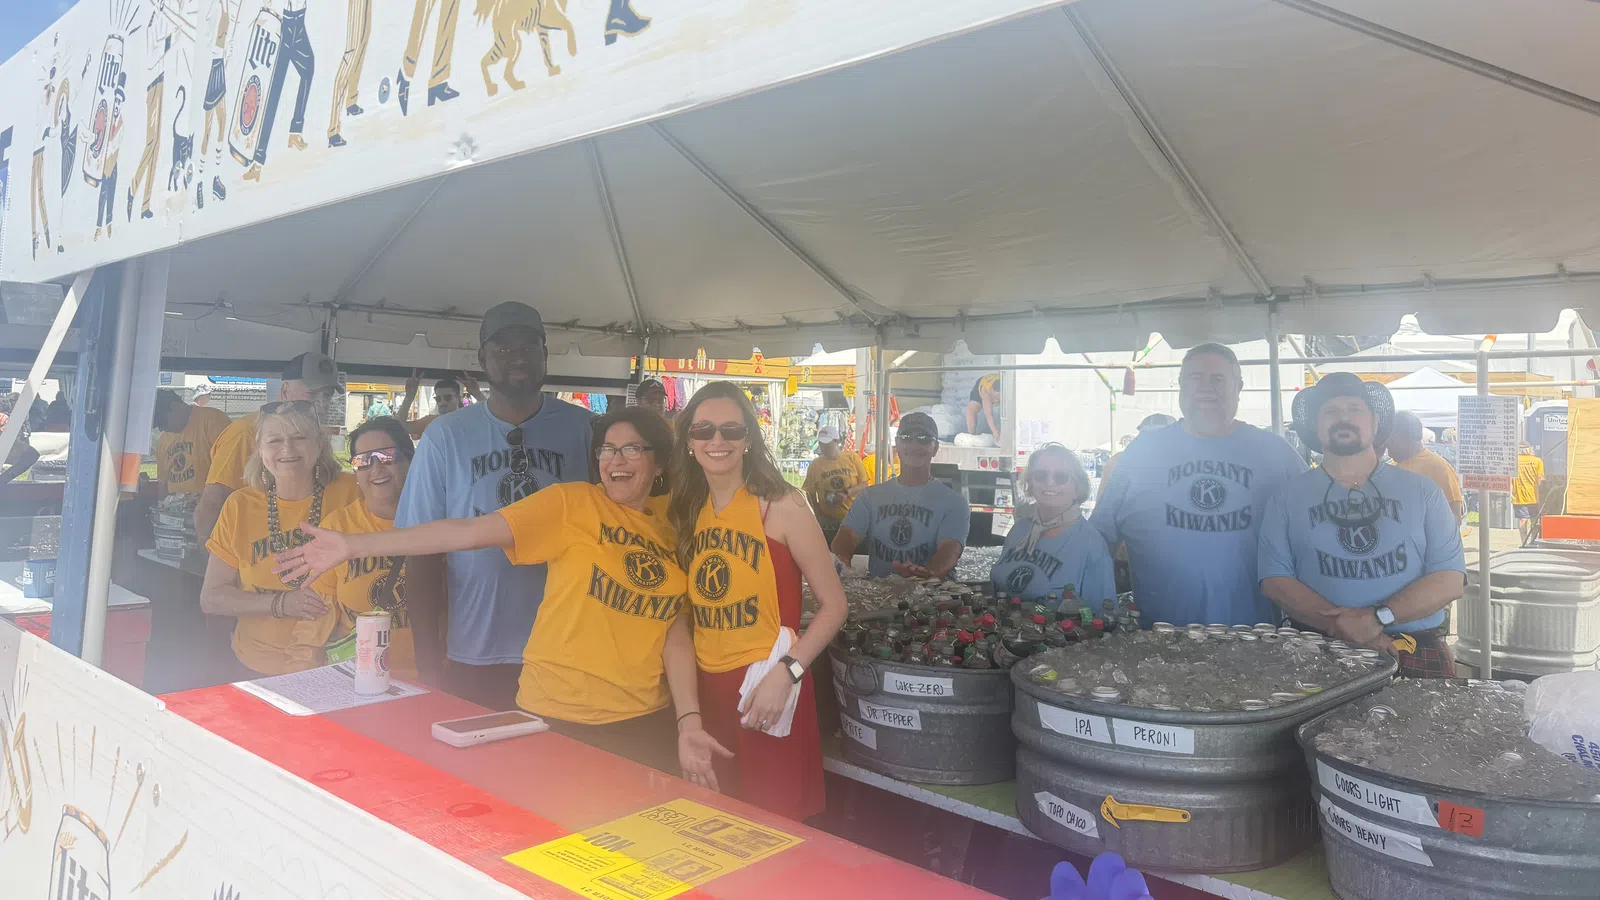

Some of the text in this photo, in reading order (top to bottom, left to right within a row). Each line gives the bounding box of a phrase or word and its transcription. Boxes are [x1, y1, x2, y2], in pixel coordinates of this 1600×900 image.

[1168, 459, 1254, 490] MOISANT
[1164, 501, 1253, 533] KIWANIS
[1315, 540, 1407, 581] KIWANIS
[586, 562, 687, 622] KIWANIS
[917, 683, 944, 696] ZERO
[882, 709, 914, 727] PEPPER
[1075, 717, 1092, 737] IPA
[1134, 726, 1177, 747] PERONI
[1335, 773, 1402, 814] COORS LIGHT
[638, 806, 697, 830] YES!
[1049, 801, 1086, 830] TOPO CHICO
[1327, 806, 1387, 850] COORS HEAVY
[1449, 808, 1474, 828] 13
[582, 831, 637, 853] NO!
